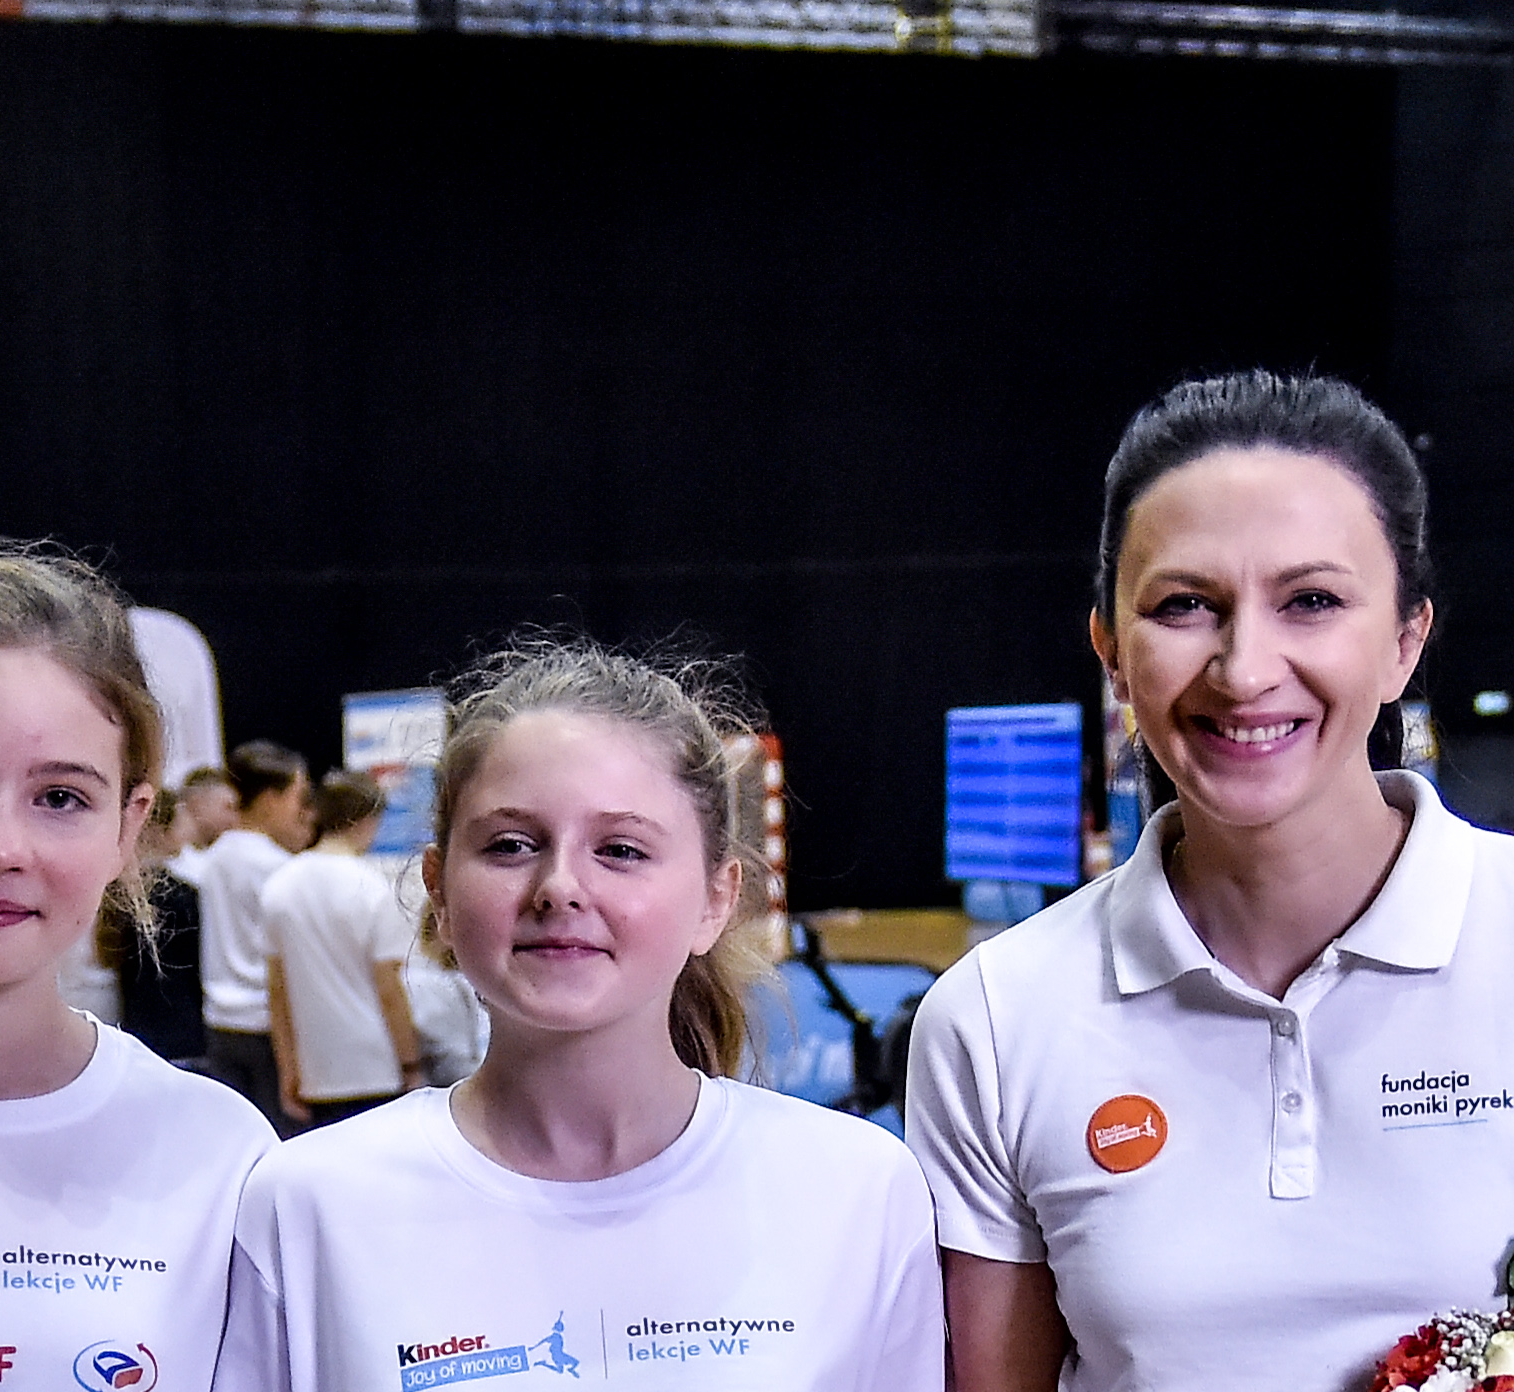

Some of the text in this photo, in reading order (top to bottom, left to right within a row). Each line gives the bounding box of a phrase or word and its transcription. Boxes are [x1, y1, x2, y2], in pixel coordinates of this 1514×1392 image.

[1381, 1070, 1470, 1094] fundacja
[1382, 1088, 1514, 1118] moniki pyrek
[2, 1244, 168, 1273] alternatywne
[3, 1269, 123, 1294] lekcje WF
[626, 1316, 795, 1337] alternatywne
[628, 1338, 750, 1362] lekcje WF
[439, 1362, 458, 1378] of
[461, 1354, 522, 1375] moving
